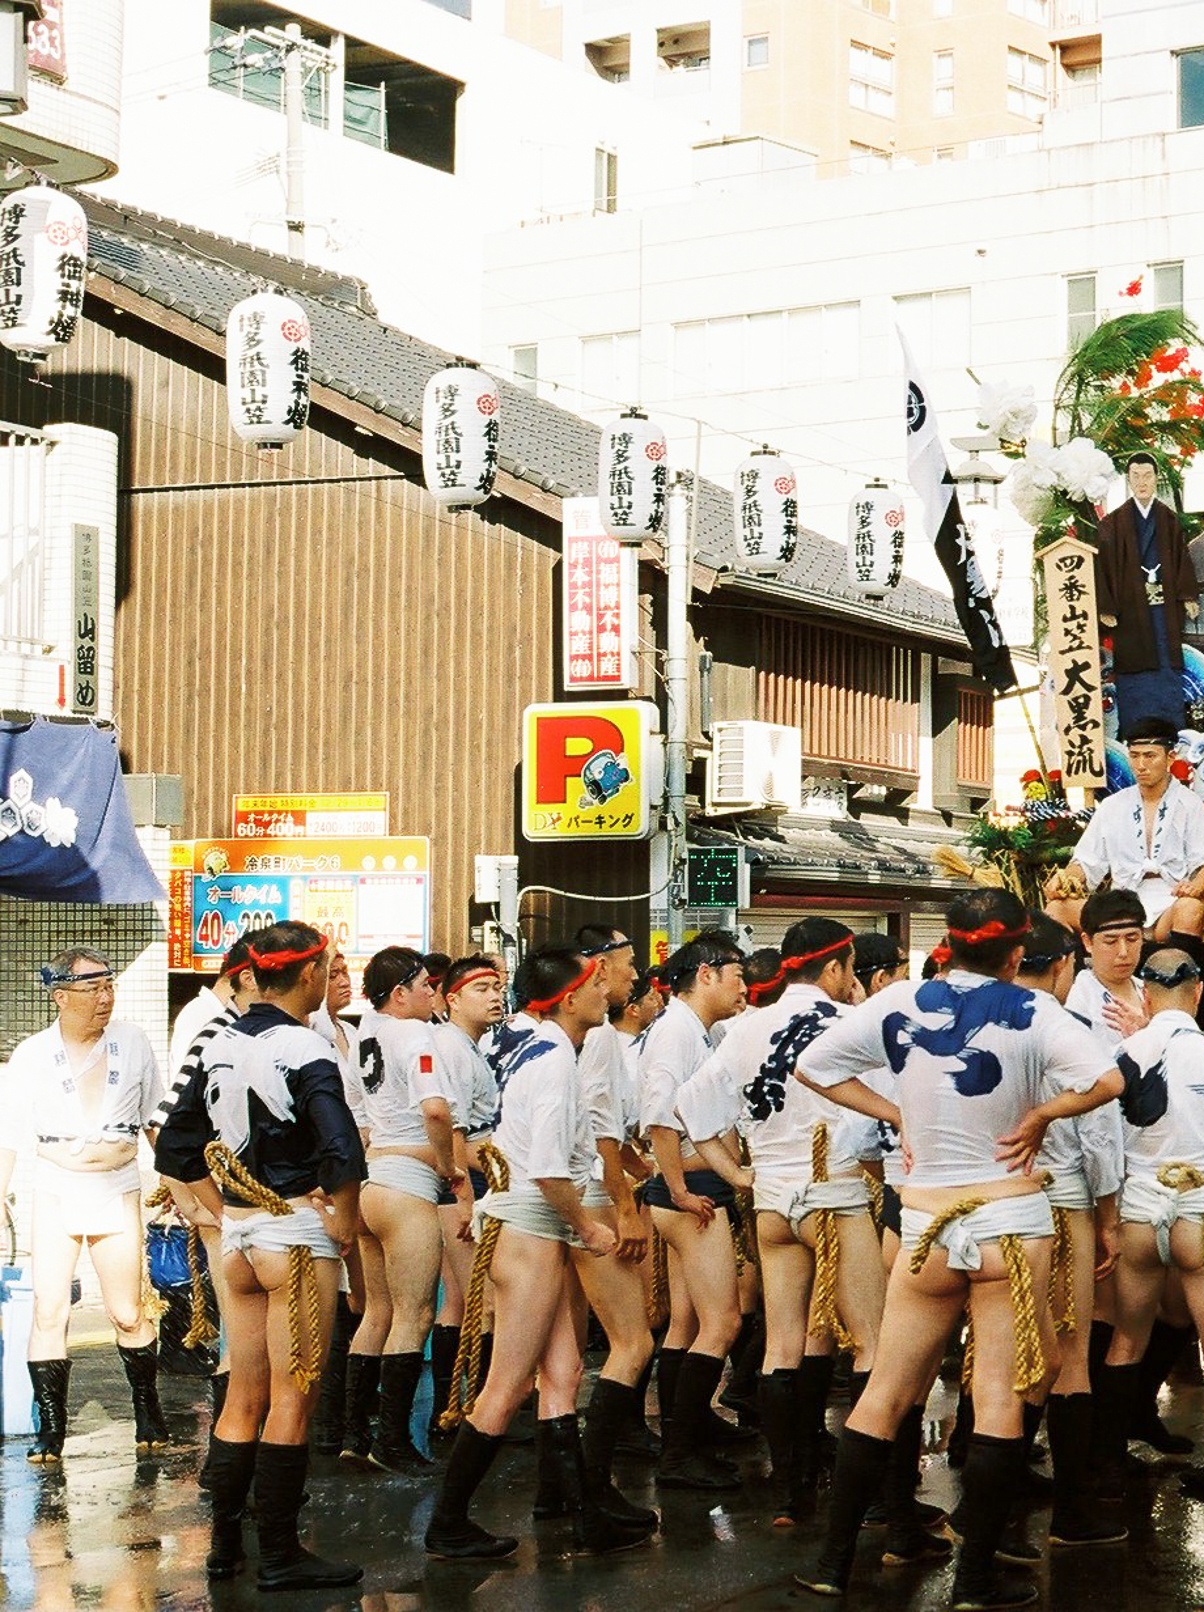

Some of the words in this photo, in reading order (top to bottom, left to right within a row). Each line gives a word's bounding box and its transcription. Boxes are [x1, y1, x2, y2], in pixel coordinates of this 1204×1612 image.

[76, 612, 95, 706] 山留め
[536, 716, 624, 804] P
[567, 813, 634, 829] パーキング
[207, 885, 282, 905] オールタイム
